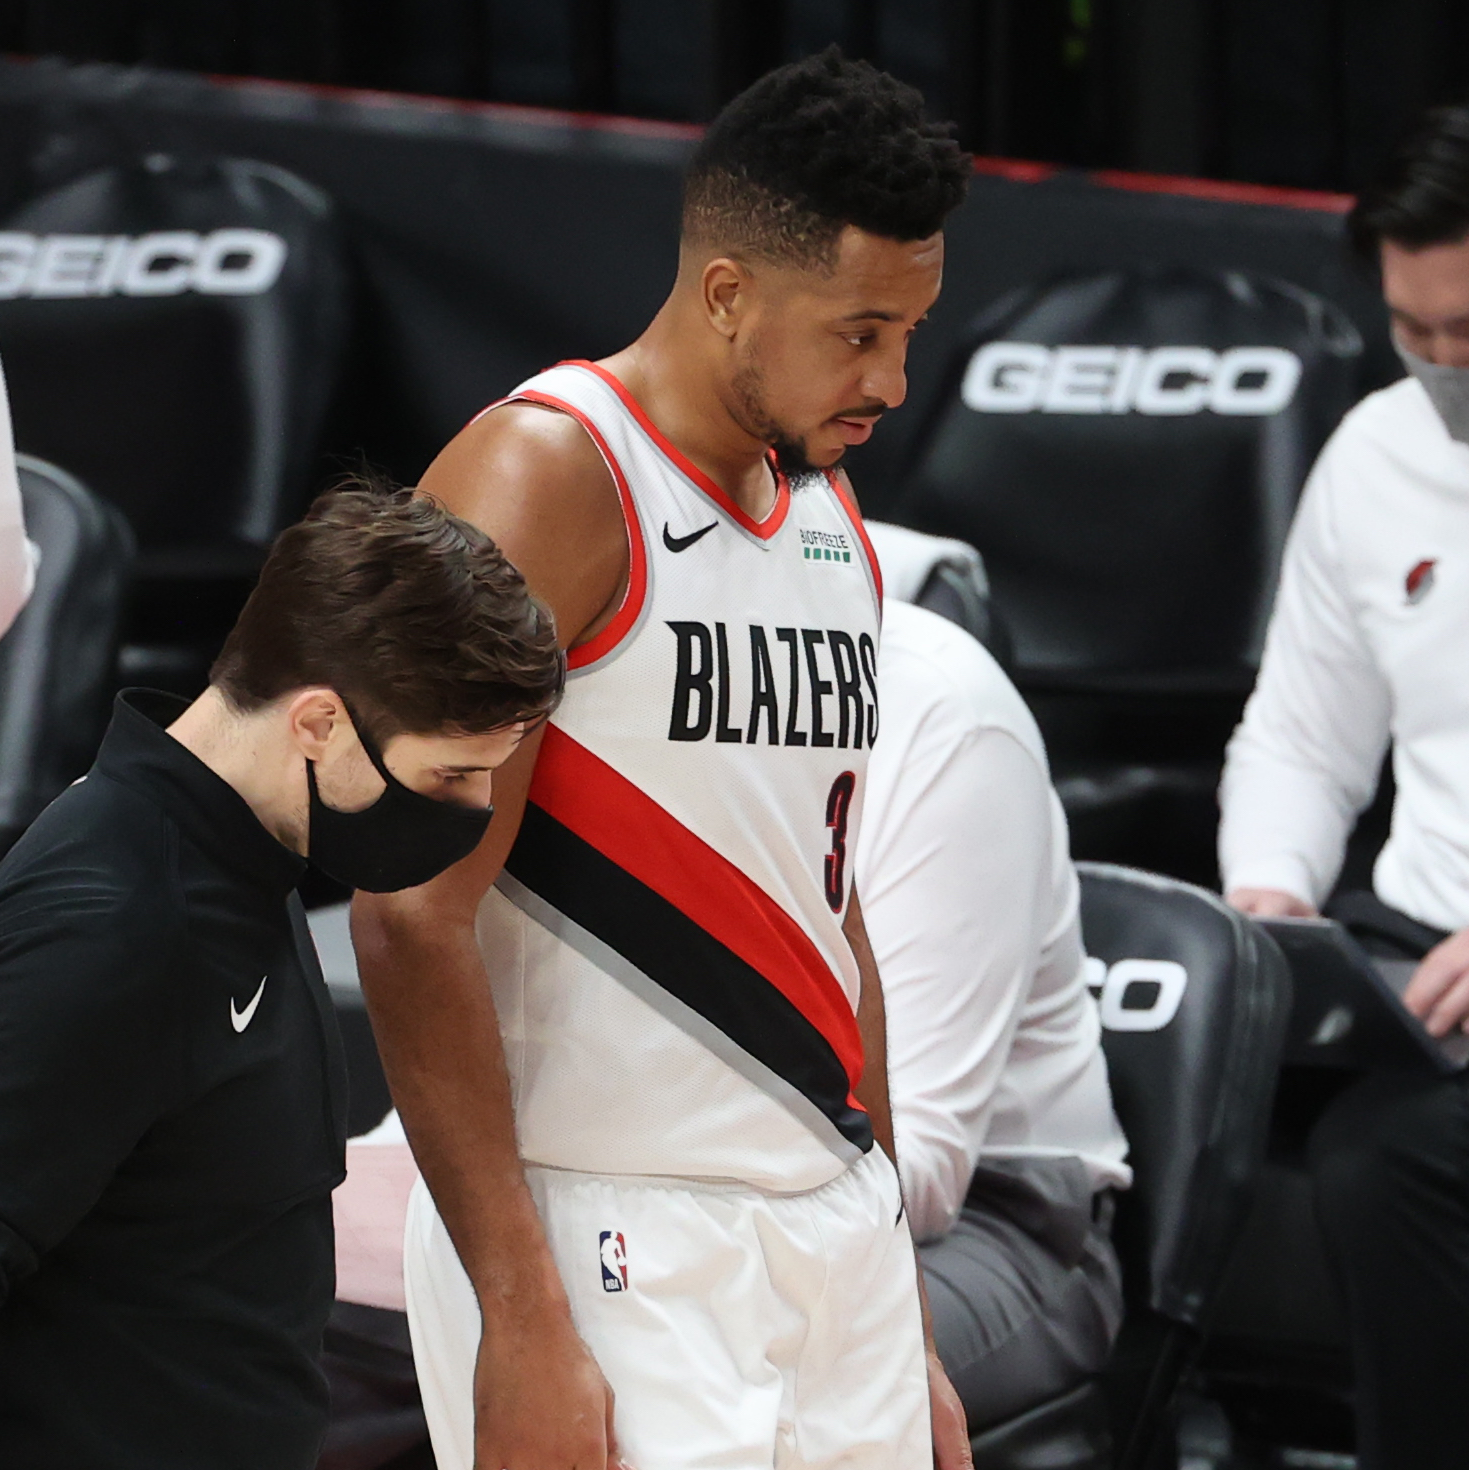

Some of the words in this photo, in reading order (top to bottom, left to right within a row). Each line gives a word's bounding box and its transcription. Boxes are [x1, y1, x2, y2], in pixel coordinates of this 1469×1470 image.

[962, 342, 1303, 416] GEICO
[664, 620, 880, 750] BLAZERS
[824, 770, 856, 914] 3
